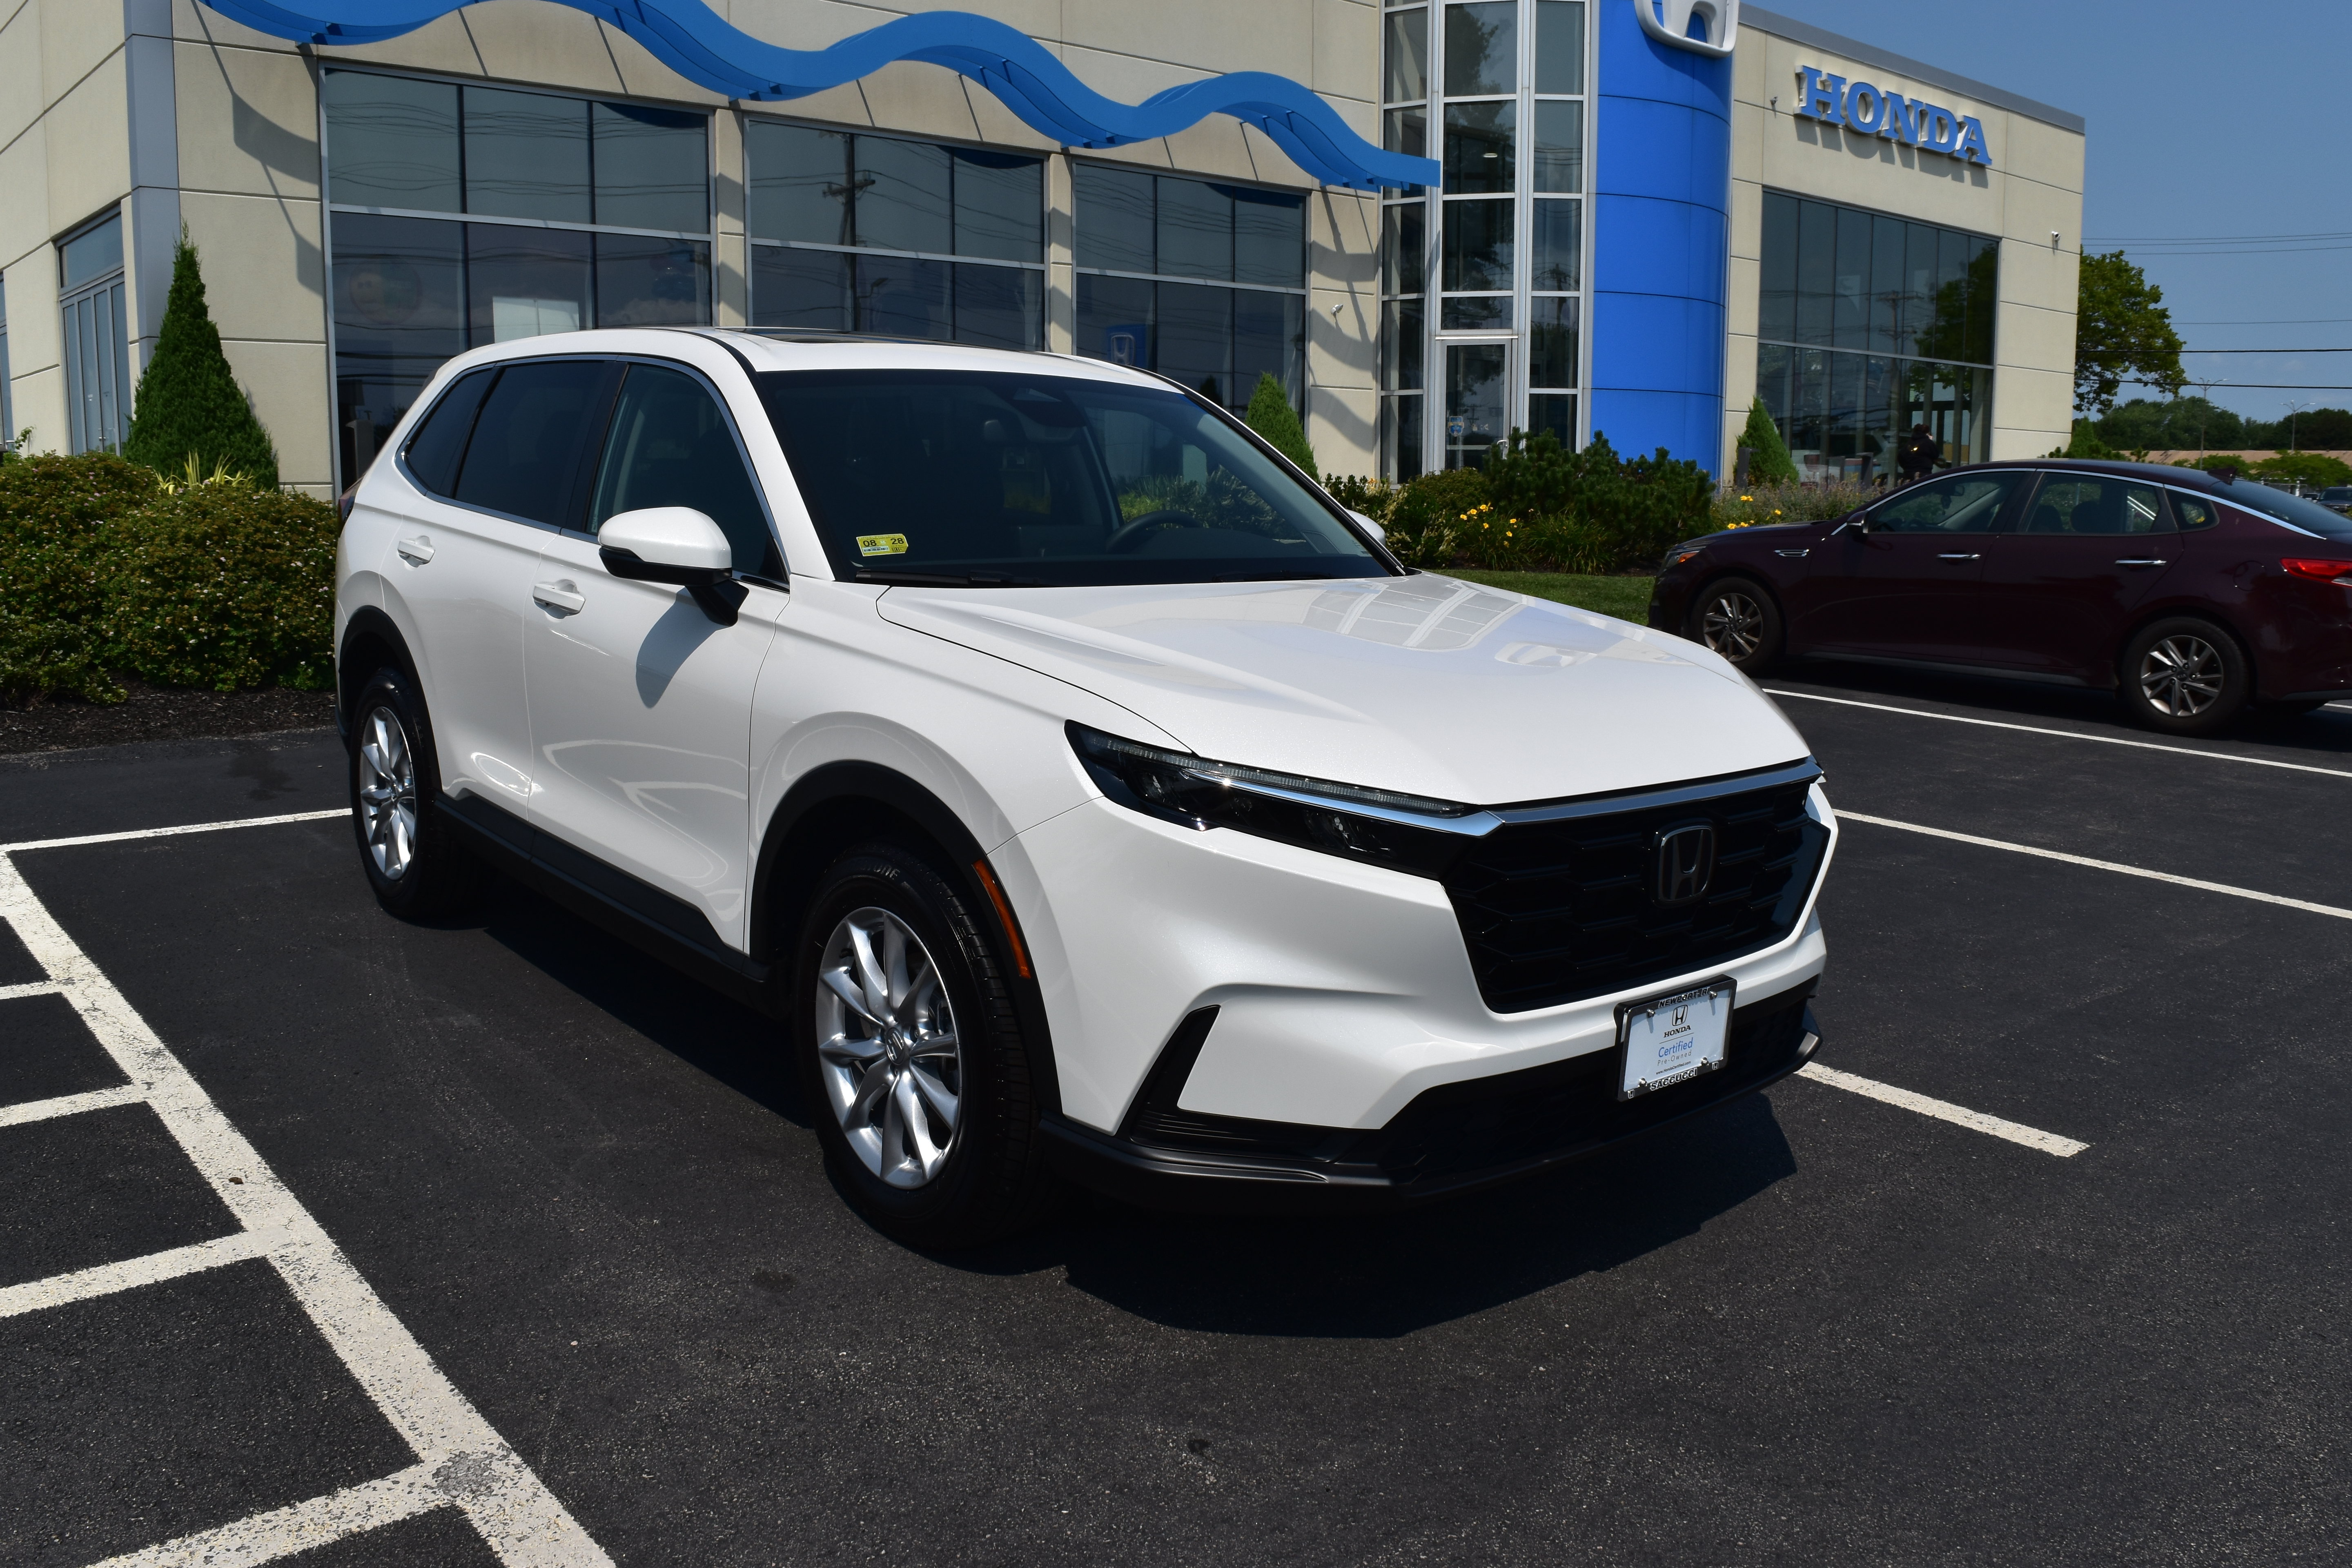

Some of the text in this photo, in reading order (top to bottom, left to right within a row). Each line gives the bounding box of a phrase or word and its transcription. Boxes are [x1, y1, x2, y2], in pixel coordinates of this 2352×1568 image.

[1794, 65, 1992, 166] HONDA
[1700, 986, 1711, 996] RI
[1663, 1025, 1691, 1038] HONDA
[1658, 1037, 1693, 1058] Certified
[1657, 1049, 1692, 1066] Pre-Owned
[1650, 1067, 1697, 1091] SACCUCCI
